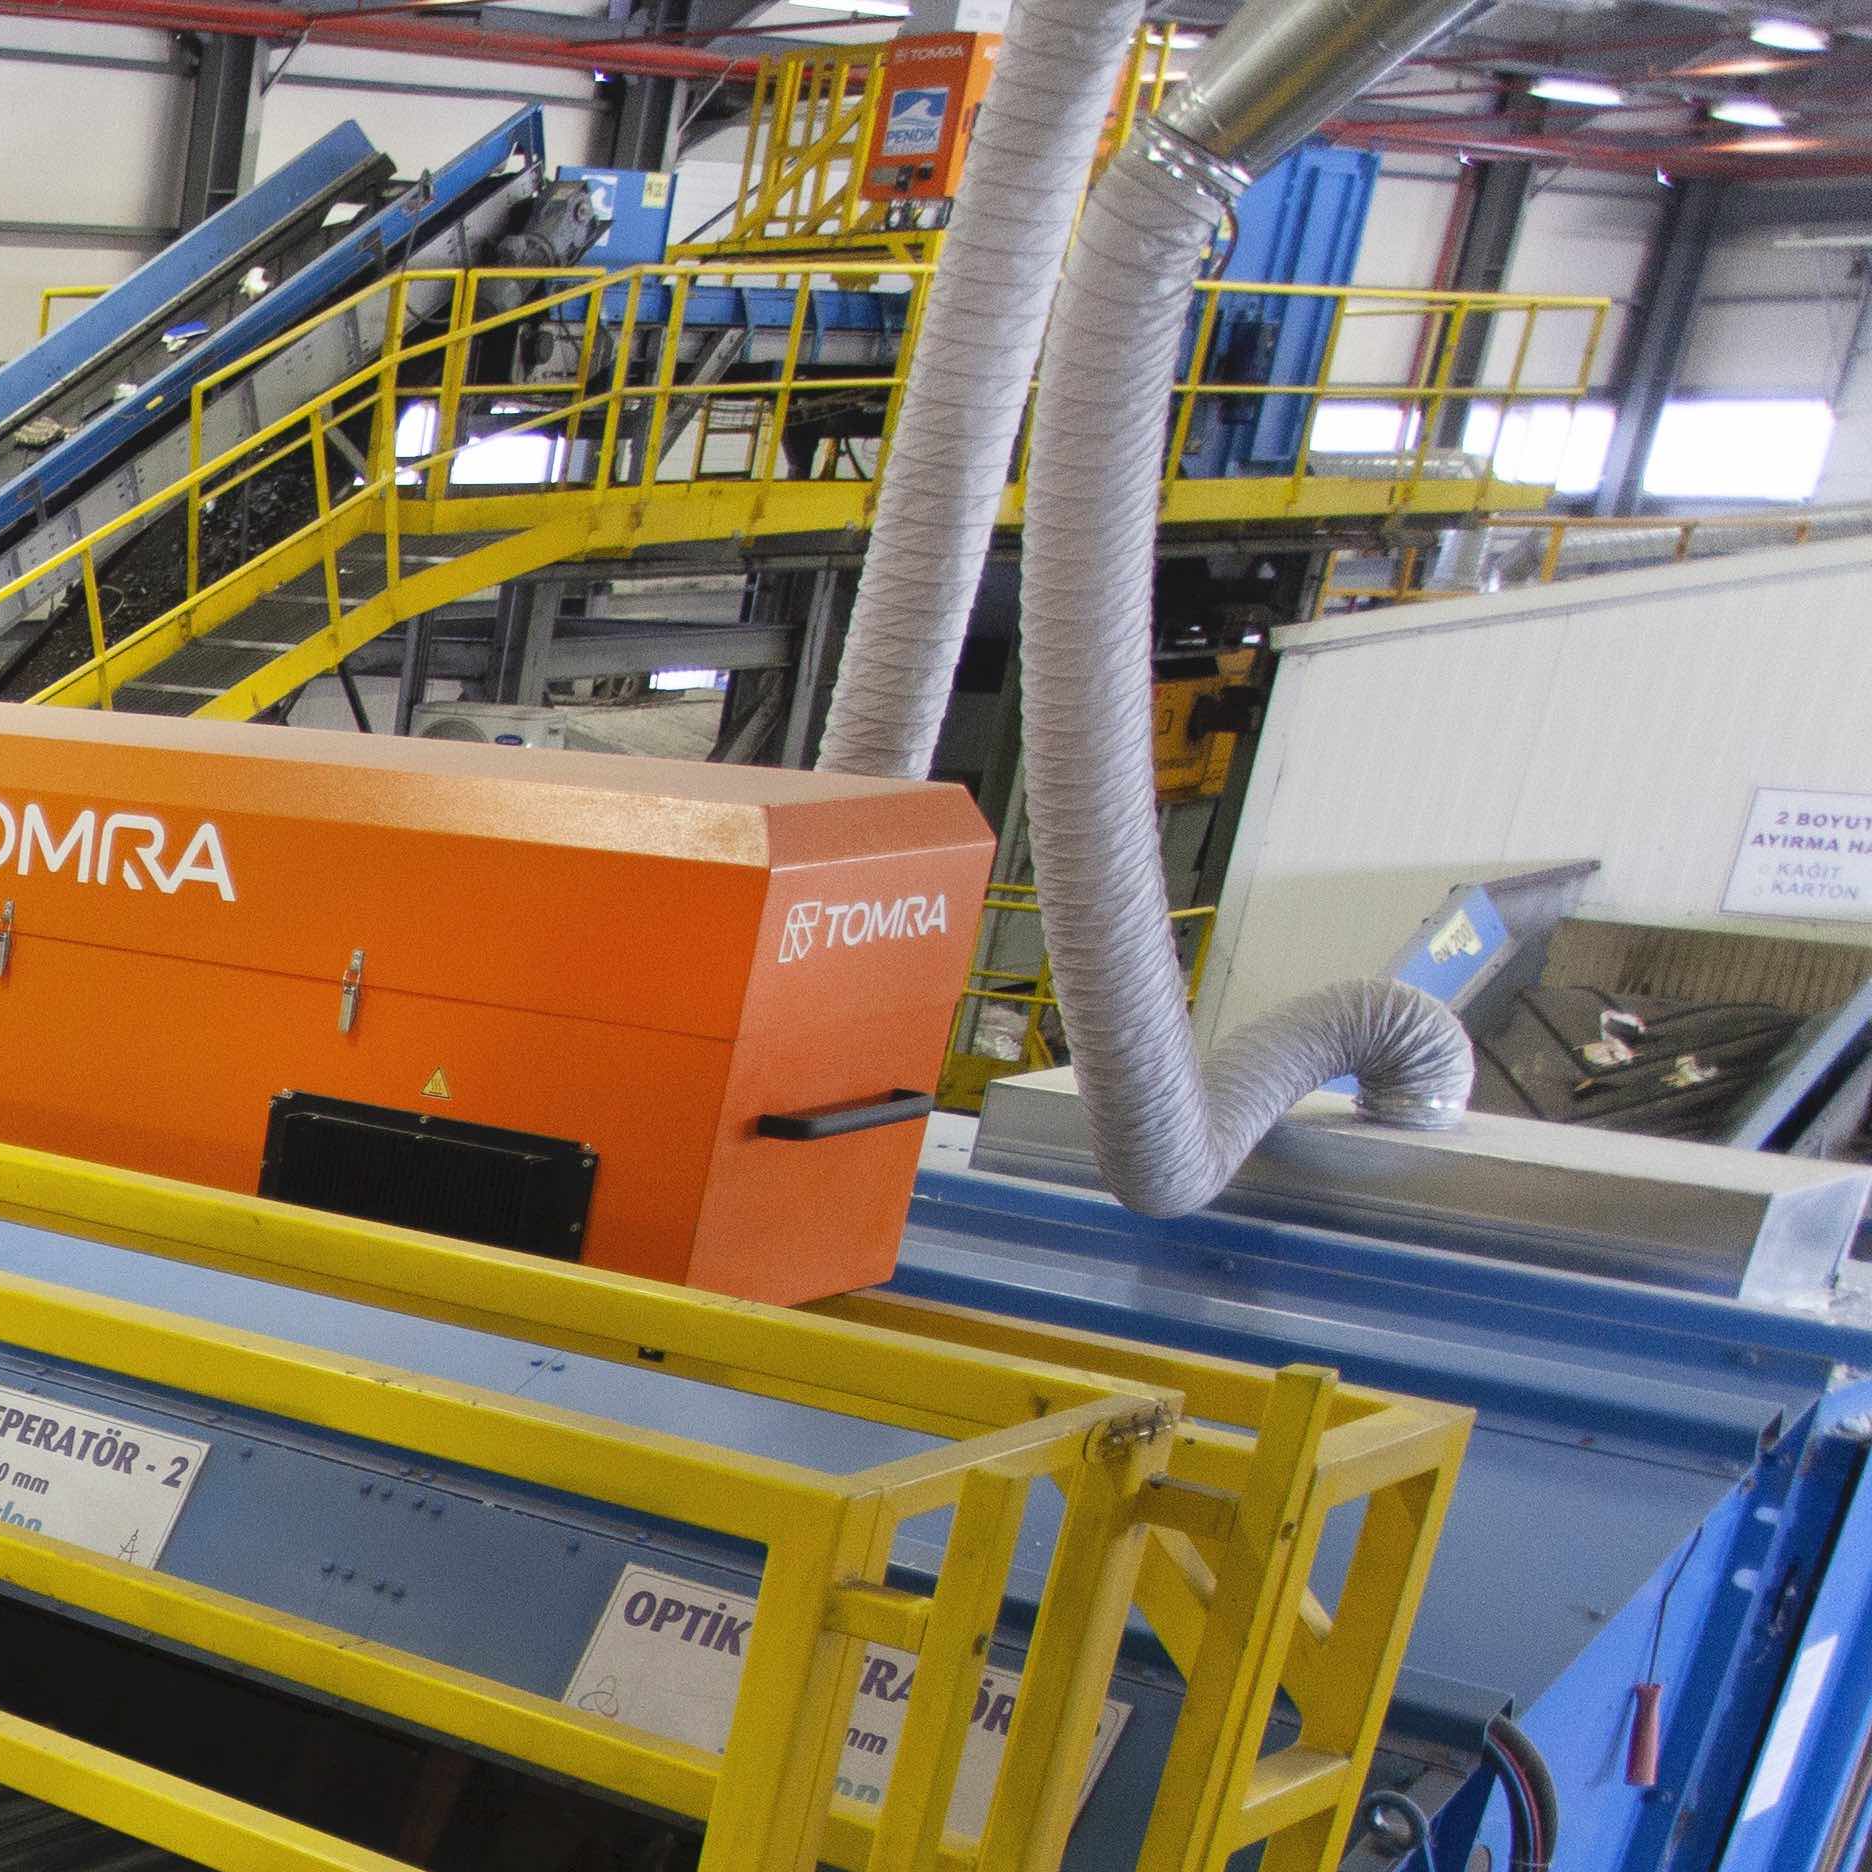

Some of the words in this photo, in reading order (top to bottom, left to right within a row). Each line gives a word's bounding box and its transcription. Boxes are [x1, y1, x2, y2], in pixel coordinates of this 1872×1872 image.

[825, 894, 948, 949] TOMRA
[11, 1471, 50, 1496] mm
[161, 1455, 190, 1489] 2
